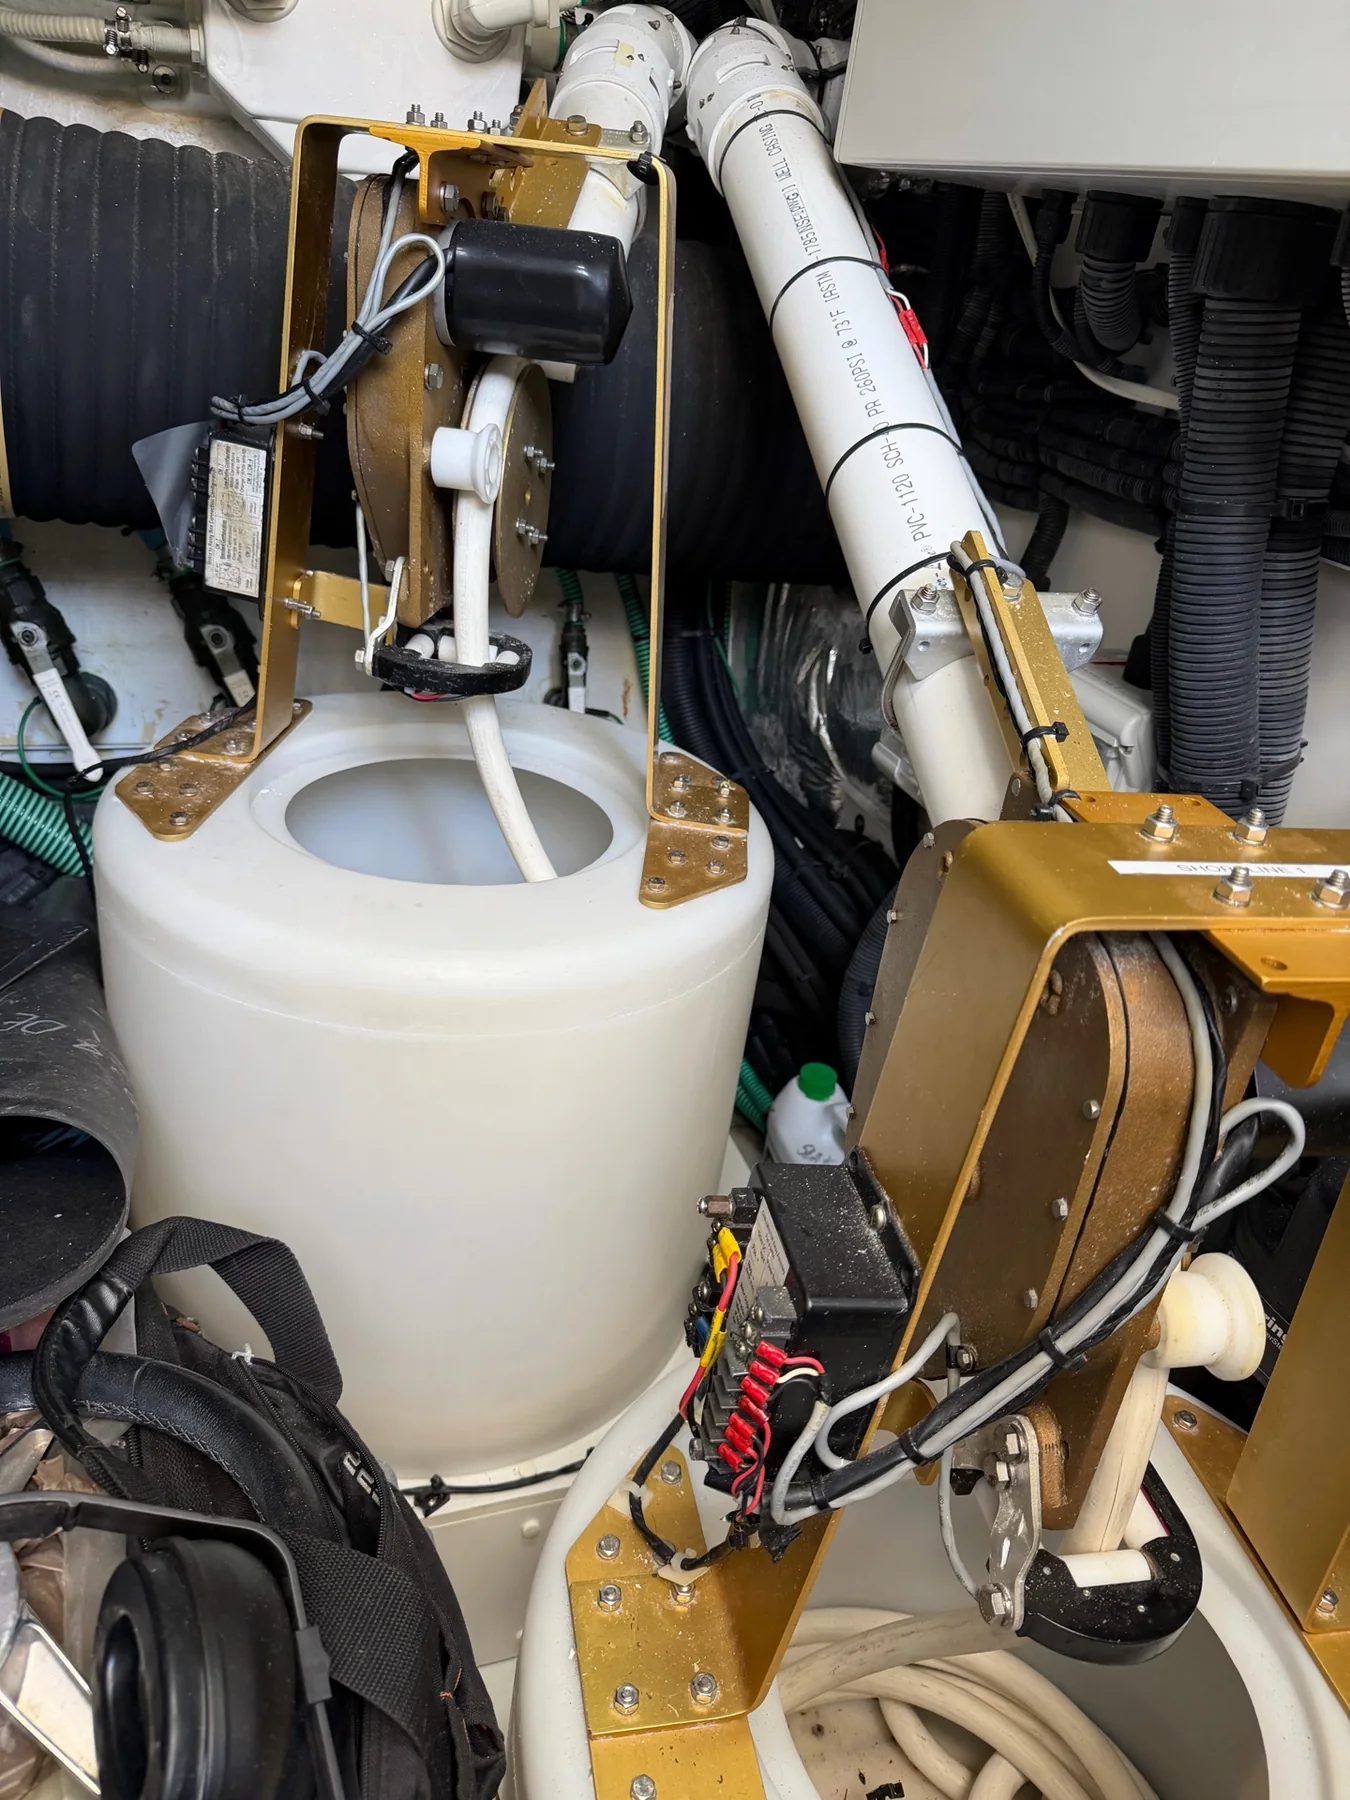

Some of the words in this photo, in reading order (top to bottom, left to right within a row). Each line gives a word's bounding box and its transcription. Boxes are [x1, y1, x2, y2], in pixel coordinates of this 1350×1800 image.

[758, 123, 783, 157] CASING
[772, 156, 792, 182] WELL
[841, 338, 858, 349] @
[846, 352, 877, 396] 260PSI
[864, 398, 885, 418] PR
[872, 421, 904, 469] SCH-0
[891, 473, 932, 542] PVC-1120
[1177, 864, 1293, 874] SHORLINE
